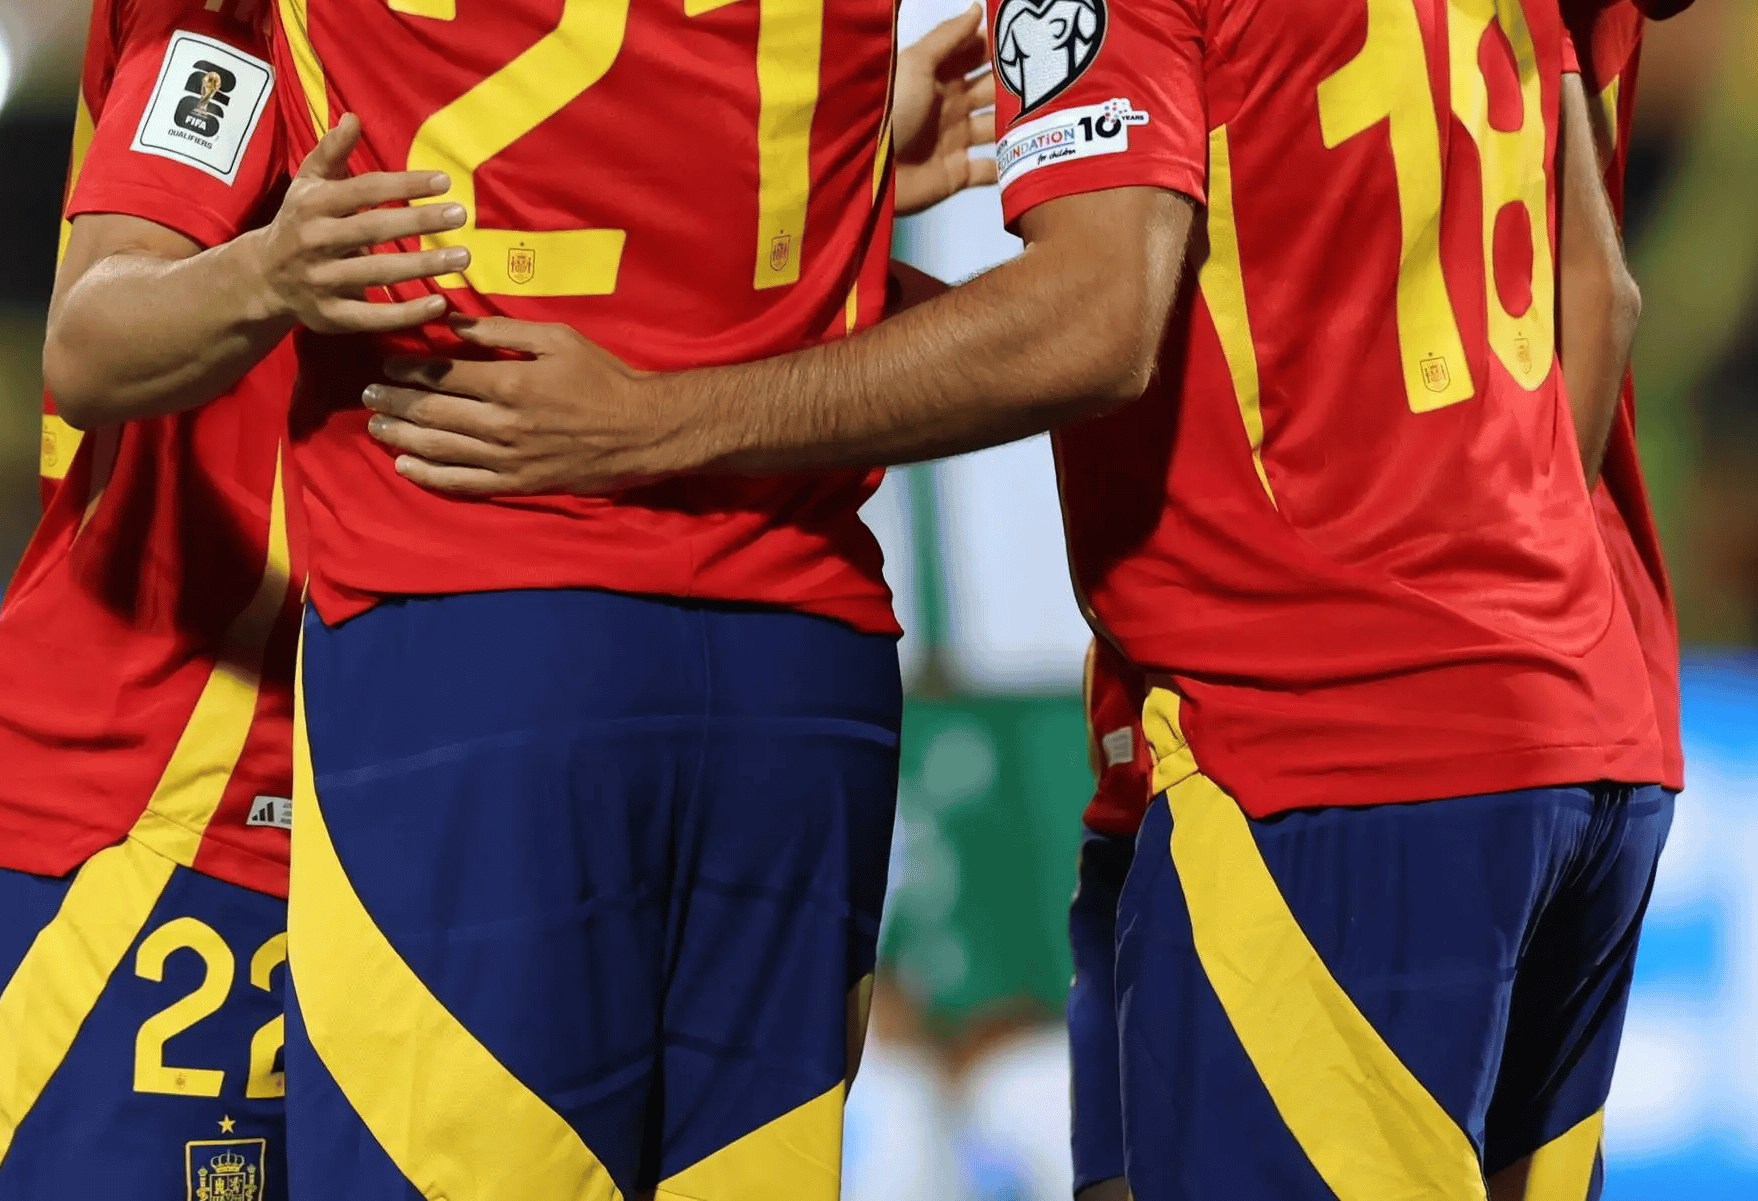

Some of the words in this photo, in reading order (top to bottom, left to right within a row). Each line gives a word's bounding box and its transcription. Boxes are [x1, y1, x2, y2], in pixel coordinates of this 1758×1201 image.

[184, 115, 207, 131] FIFA
[1078, 114, 1122, 141] 10
[167, 128, 213, 150] QUALIFIERS
